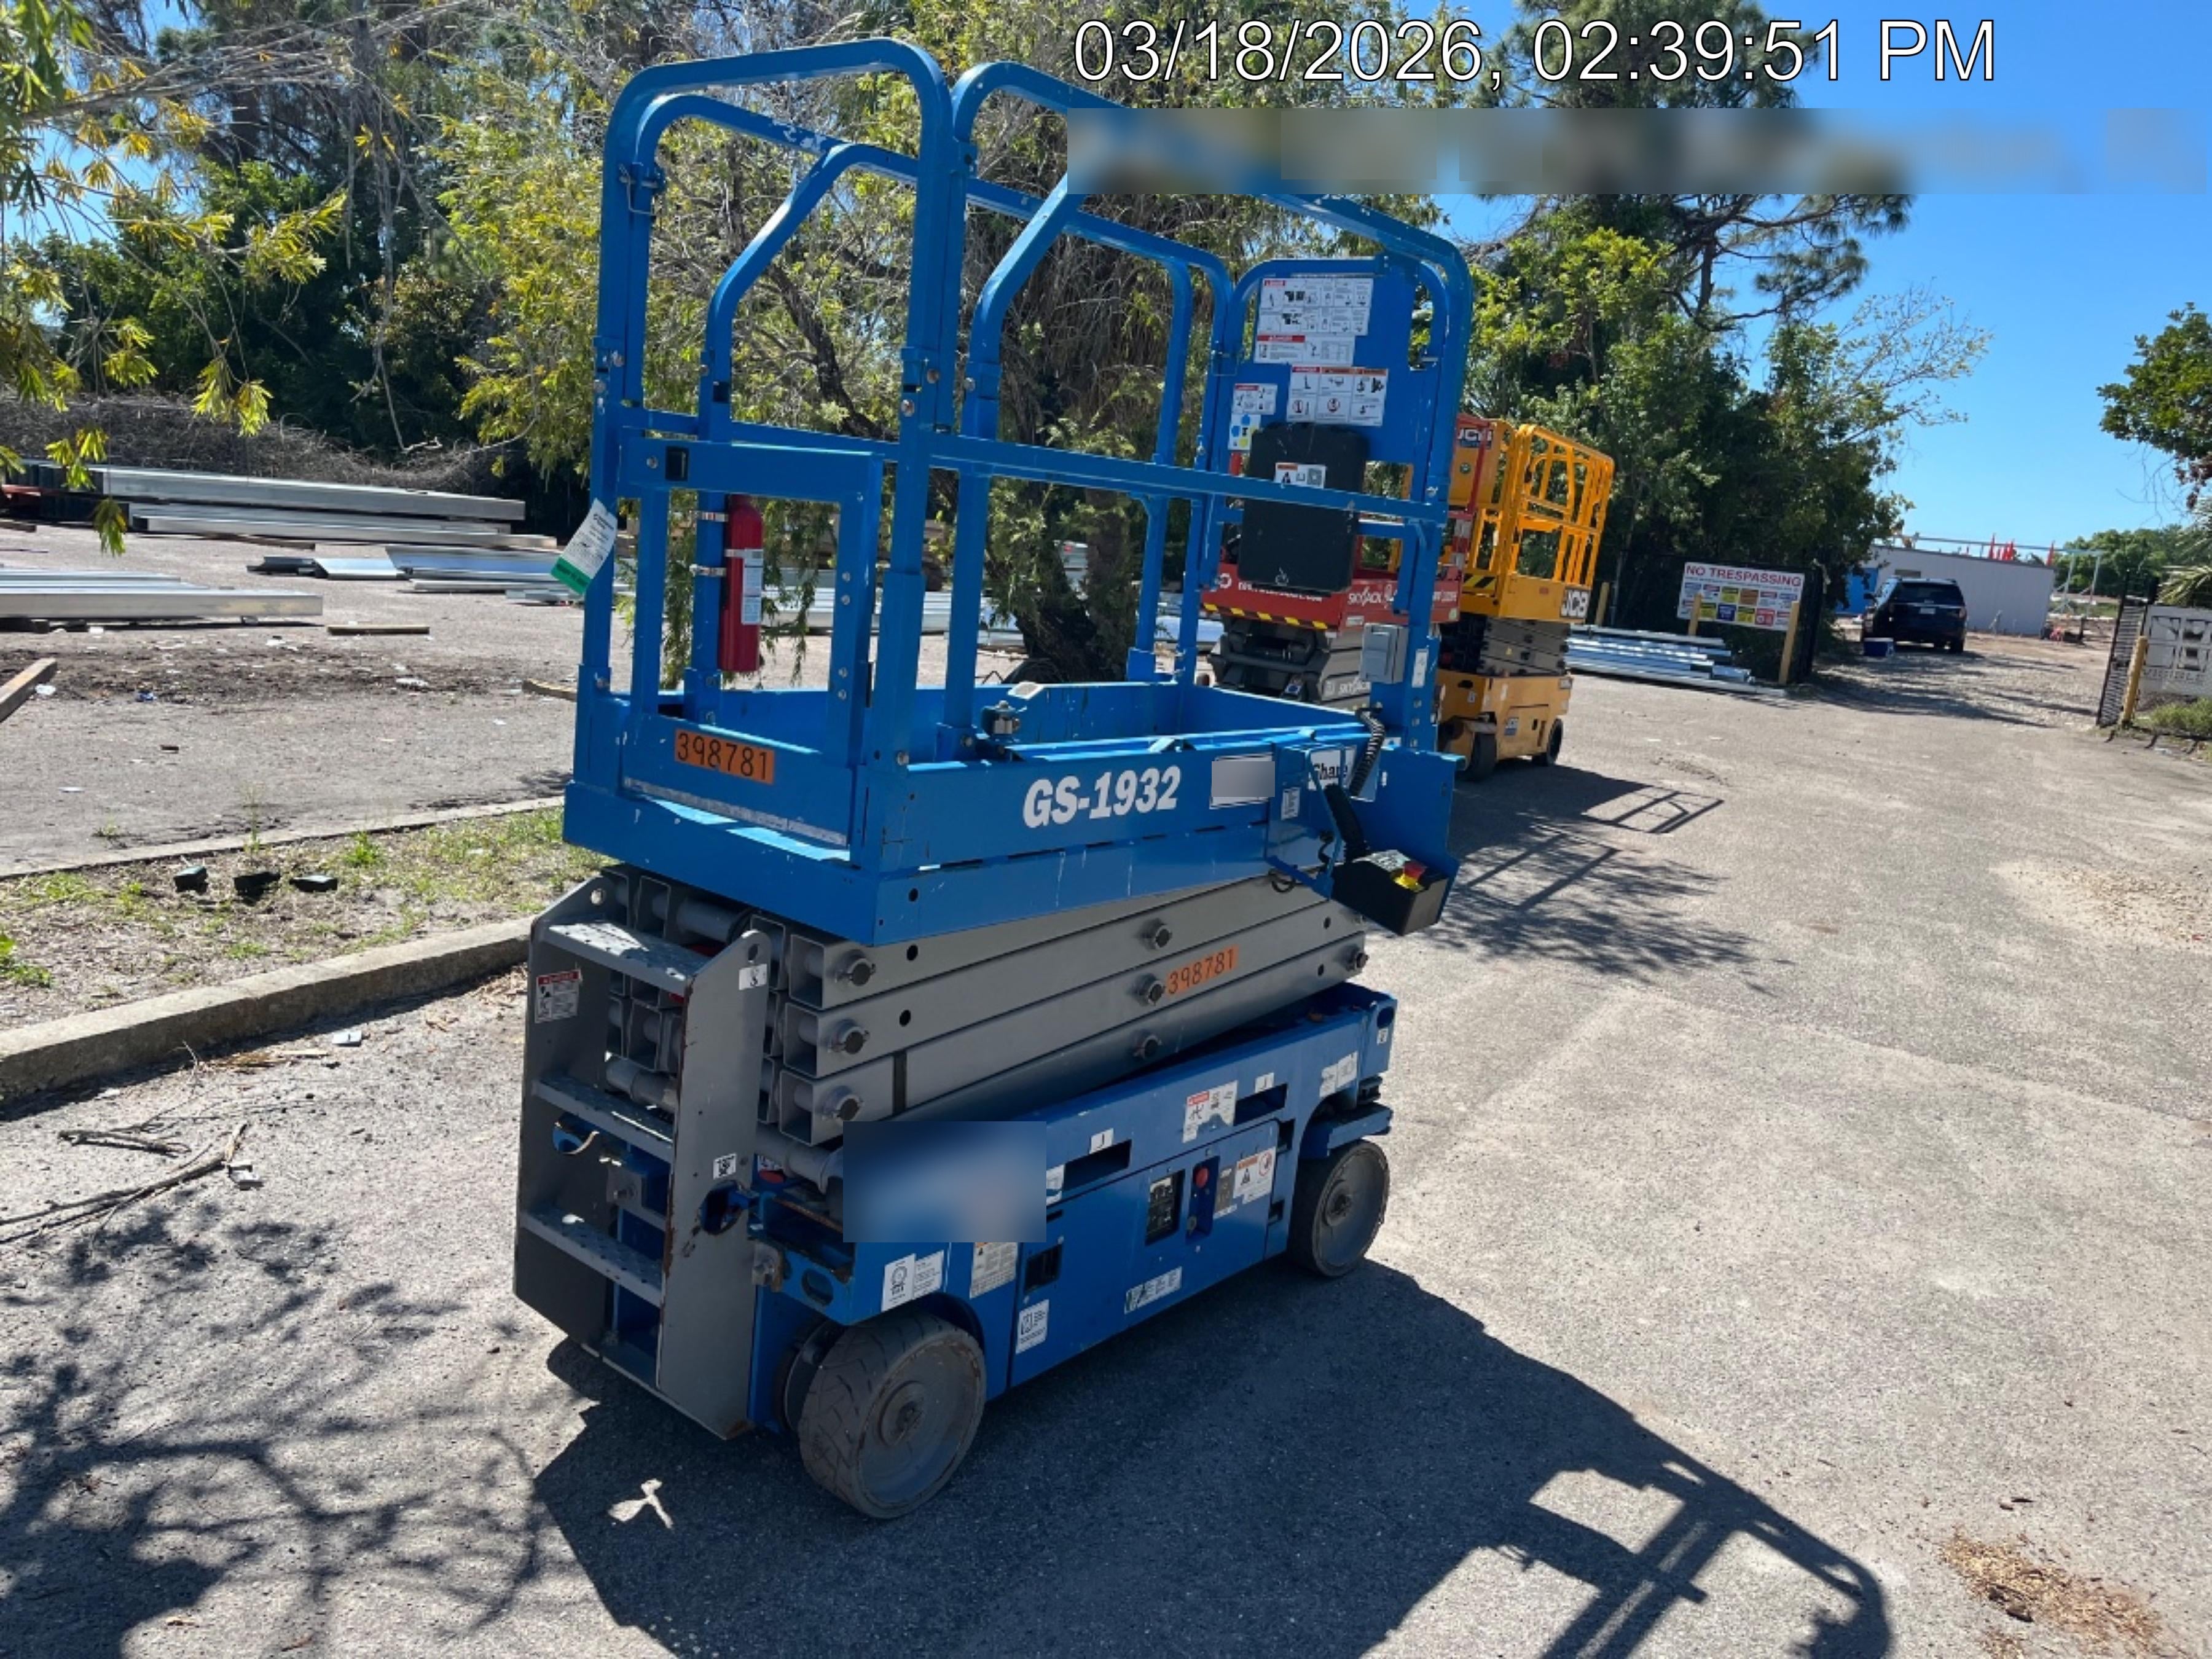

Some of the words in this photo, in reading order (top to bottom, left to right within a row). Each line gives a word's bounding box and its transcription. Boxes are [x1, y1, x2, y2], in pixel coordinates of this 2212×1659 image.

[1685, 565, 1706, 577] NO
[1709, 567, 1802, 587] TRESPASSING
[1561, 589, 1589, 617] JCB
[677, 732, 767, 780] 398781
[1022, 765, 1181, 828] GS-1932
[1167, 948, 1234, 995] 398781
